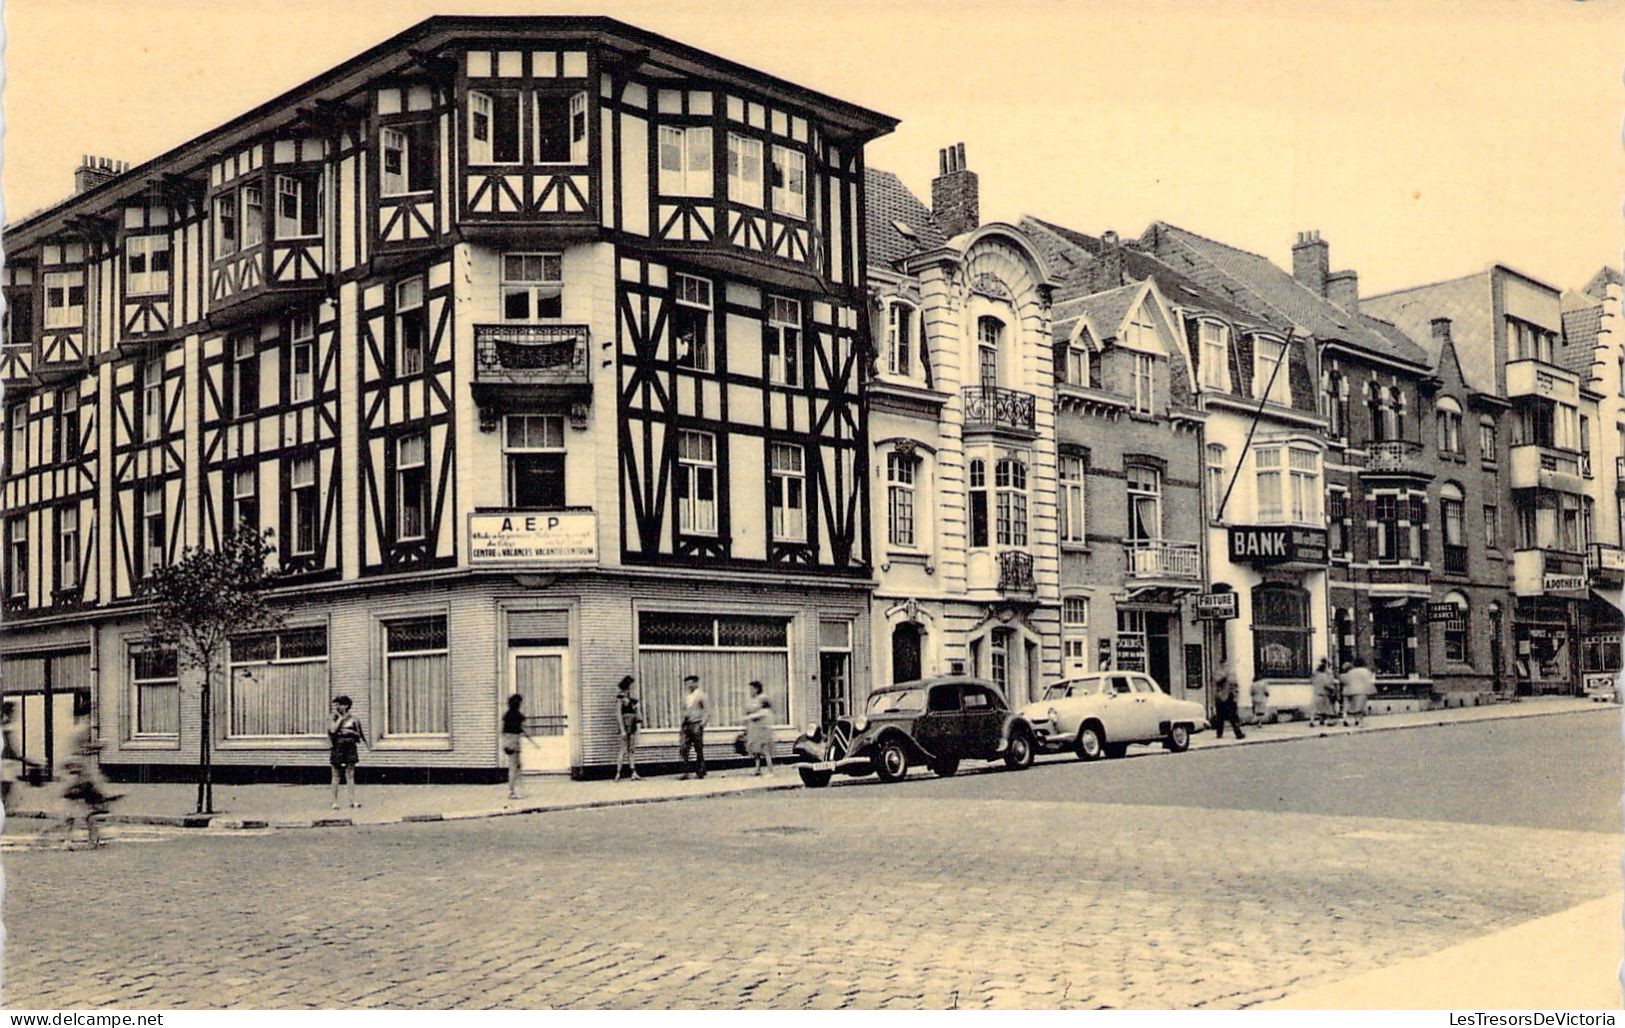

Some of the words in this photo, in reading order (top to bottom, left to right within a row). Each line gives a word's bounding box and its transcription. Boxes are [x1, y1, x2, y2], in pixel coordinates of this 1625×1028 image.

[1234, 531, 1287, 557] BANK
[473, 548, 496, 558] CENTRE
[1545, 577, 1583, 589] APOTHEEK
[1199, 594, 1232, 606] FRITURE
